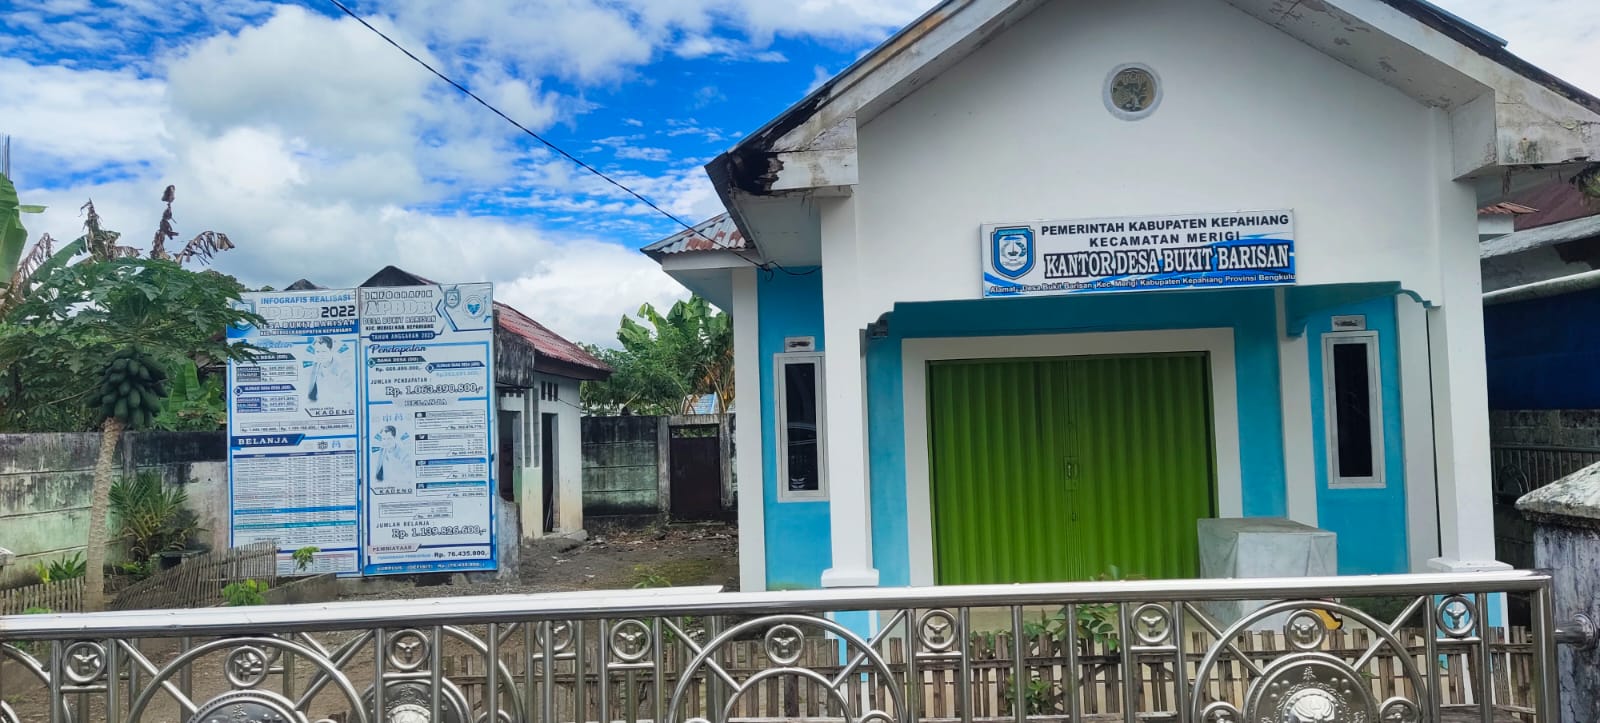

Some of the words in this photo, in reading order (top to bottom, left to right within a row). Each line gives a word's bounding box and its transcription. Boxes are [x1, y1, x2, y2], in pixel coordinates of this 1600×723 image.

[1041, 222, 1124, 236] PEMERINTAH
[1129, 218, 1207, 232] KABUPATEN
[1211, 214, 1289, 228] KEPAHIANG
[1089, 234, 1180, 248] KECAMATAN
[1187, 231, 1240, 243] MERIGI
[1044, 251, 1114, 279] KANTOR
[1115, 249, 1160, 276] DESA
[1161, 246, 1214, 273] BUKIT
[1216, 243, 1290, 270] BARISAN
[1140, 278, 1181, 287] Kabupaten
[1182, 276, 1223, 285] Kepahiang
[1225, 274, 1256, 282] Provinsi
[1258, 273, 1296, 282] Bengkulu
[261, 296, 308, 305] INFOGRAFIS
[309, 294, 351, 303] REALISASI
[321, 305, 356, 318] 2022
[313, 319, 355, 328] BARISAN
[368, 343, 427, 356] Pendapatan
[385, 386, 403, 398] Rp.
[238, 437, 289, 445] BELANJA
[392, 528, 409, 540] Rp.
